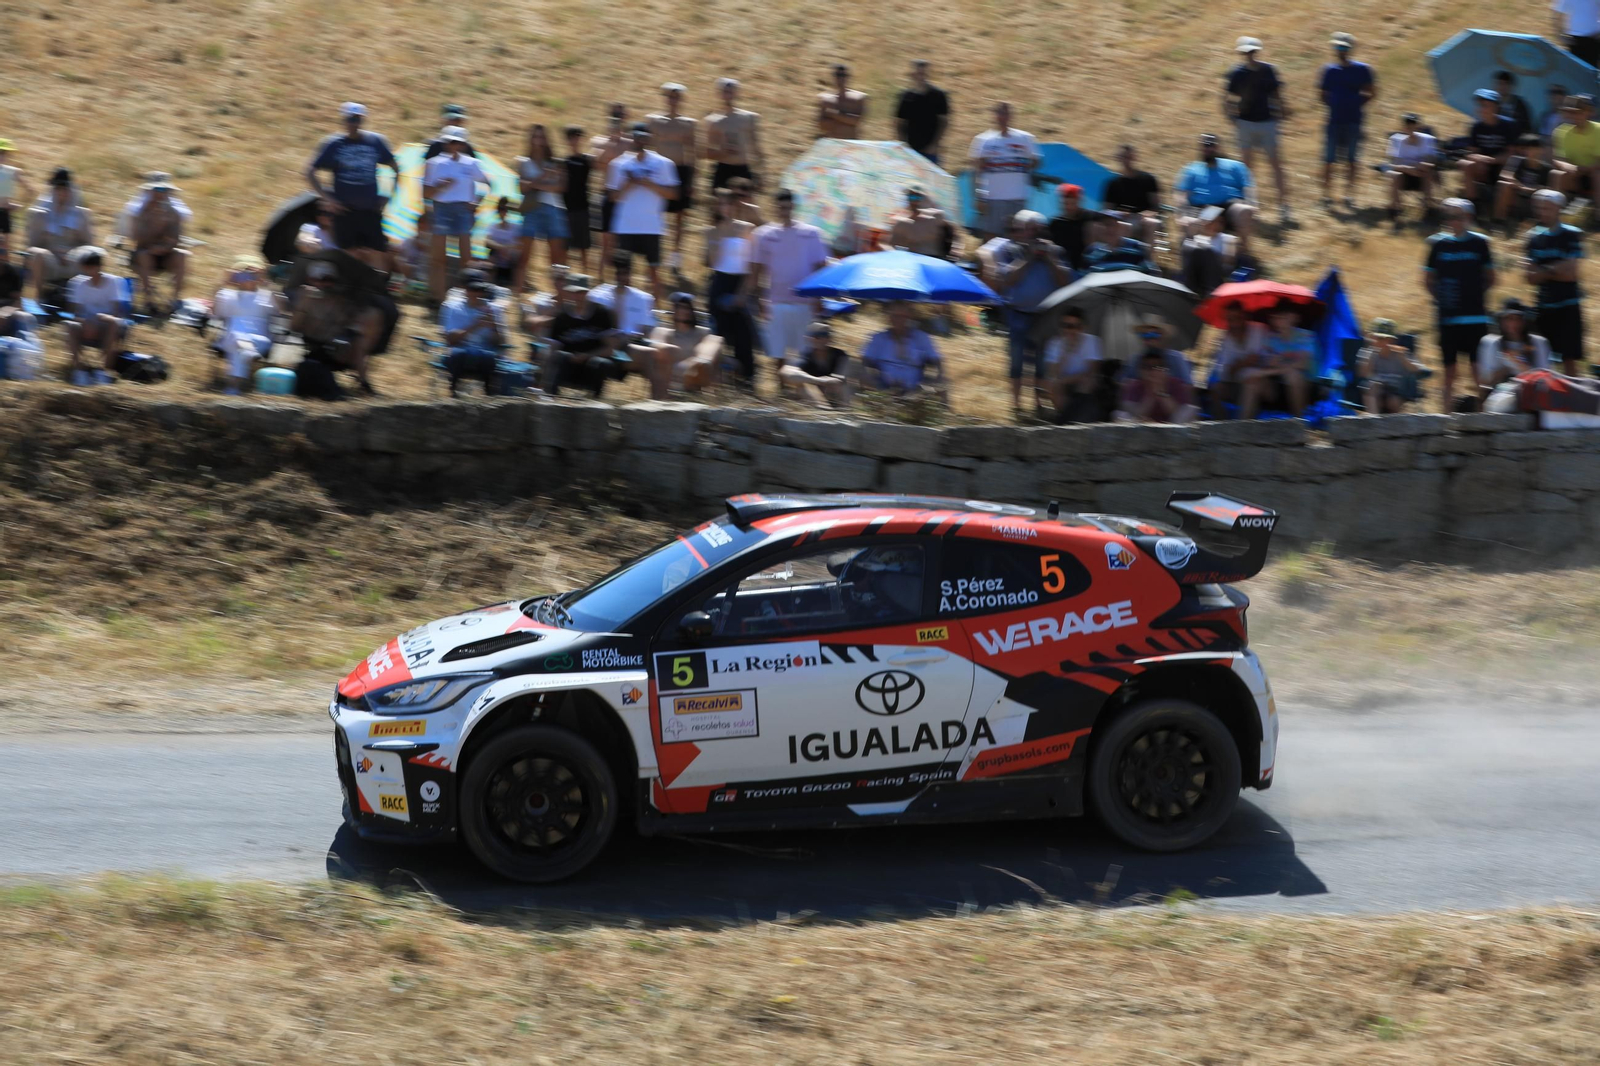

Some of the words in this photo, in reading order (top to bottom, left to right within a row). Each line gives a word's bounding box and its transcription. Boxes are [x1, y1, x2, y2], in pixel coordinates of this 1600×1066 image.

[1040, 554, 1065, 594] 5
[940, 577, 1004, 596] S.Pérez
[939, 588, 1038, 612] A.Coronado
[919, 628, 946, 641] RACC
[973, 600, 1138, 656] WERACE
[582, 648, 621, 660] RENTAL
[582, 655, 643, 669] MOTORBIKE
[672, 656, 694, 687] 5
[711, 659, 740, 674] La
[687, 696, 729, 711] Recalvi
[374, 720, 422, 736] PIRELLI
[733, 718, 755, 728] salud
[788, 716, 997, 765] IGUALADA
[977, 741, 1071, 770] grupbasols.com
[714, 792, 736, 802] GR
[744, 786, 798, 799] TOYOTA
[801, 781, 852, 793] GAZOO
[856, 776, 904, 790] Racing
[908, 769, 952, 784] Spain
[381, 796, 405, 811] RACC
